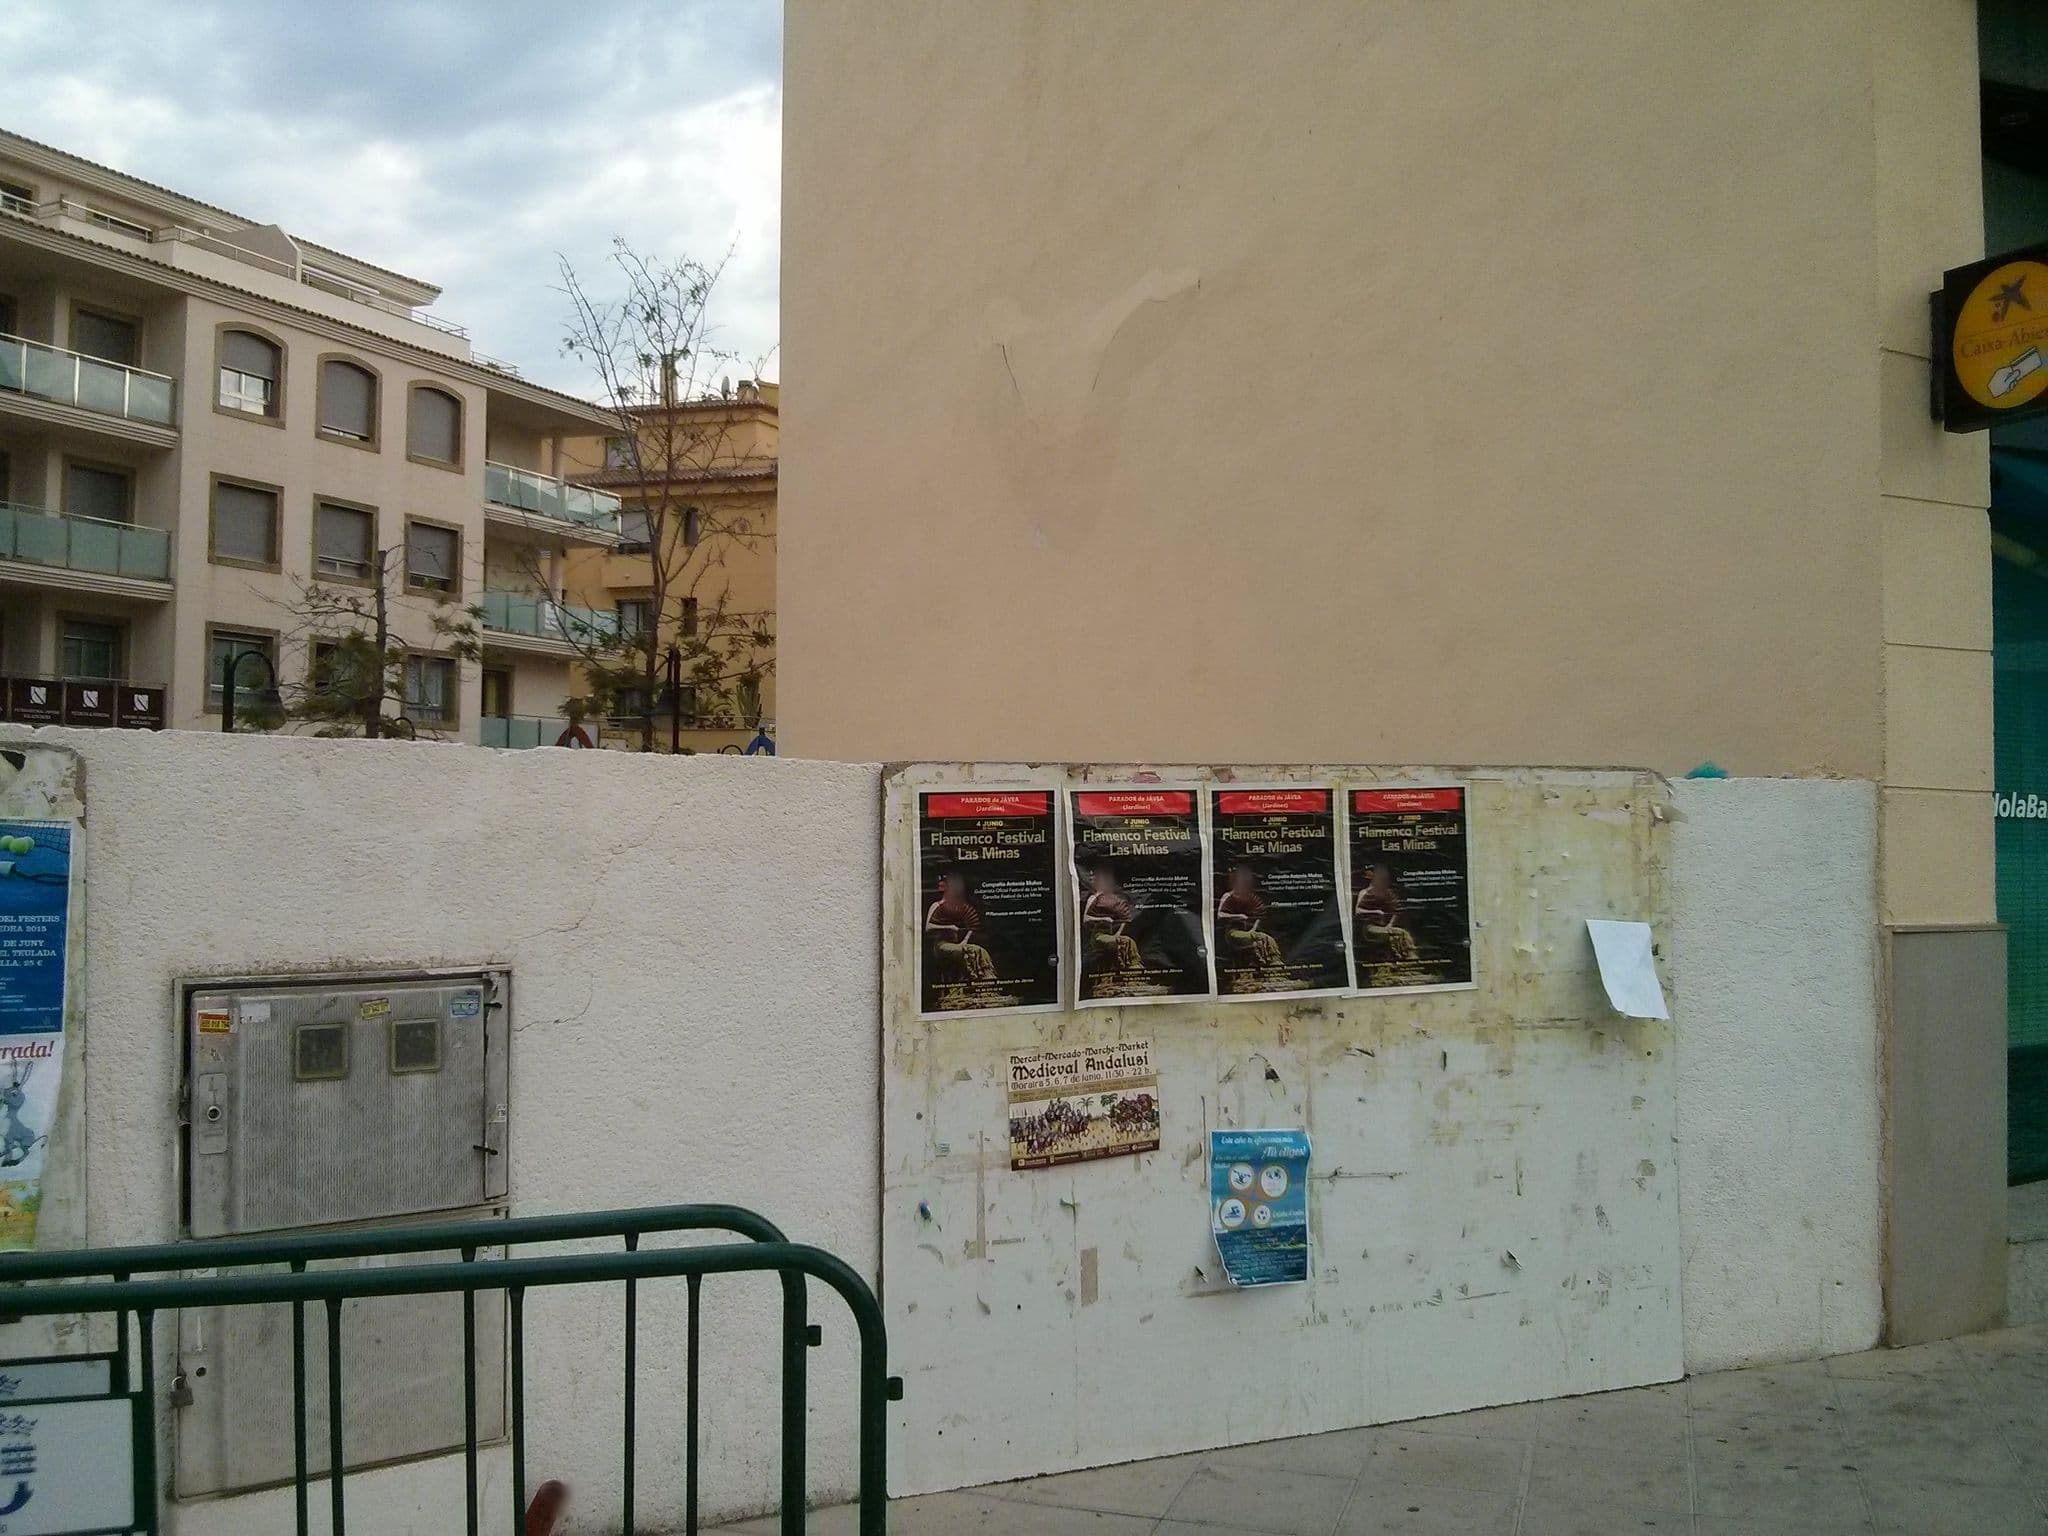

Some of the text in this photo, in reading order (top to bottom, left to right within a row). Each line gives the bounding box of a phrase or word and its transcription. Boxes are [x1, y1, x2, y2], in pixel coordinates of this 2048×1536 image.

[1083, 828, 1191, 842] Flamenco Festival
[1222, 825, 1325, 840] Flamenco Festival
[1359, 823, 1458, 838] Flamenco Festival
[931, 830, 1045, 846] Flamenco Festival
[1109, 843, 1169, 856] Las Minas
[1246, 841, 1303, 854] Las Minas
[1382, 839, 1437, 852] Las Minas
[958, 846, 1020, 860] Las Minas
[18, 915, 60, 923] FESTERS
[25, 925, 47, 933] 2015
[18, 940, 45, 948] JUNY
[12, 949, 57, 957] TEULADA
[1012, 1060, 1079, 1081] Medieval
[1011, 1079, 1044, 1090] Moraira
[1070, 1074, 1081, 1083] de
[1132, 1067, 1143, 1076] 22
